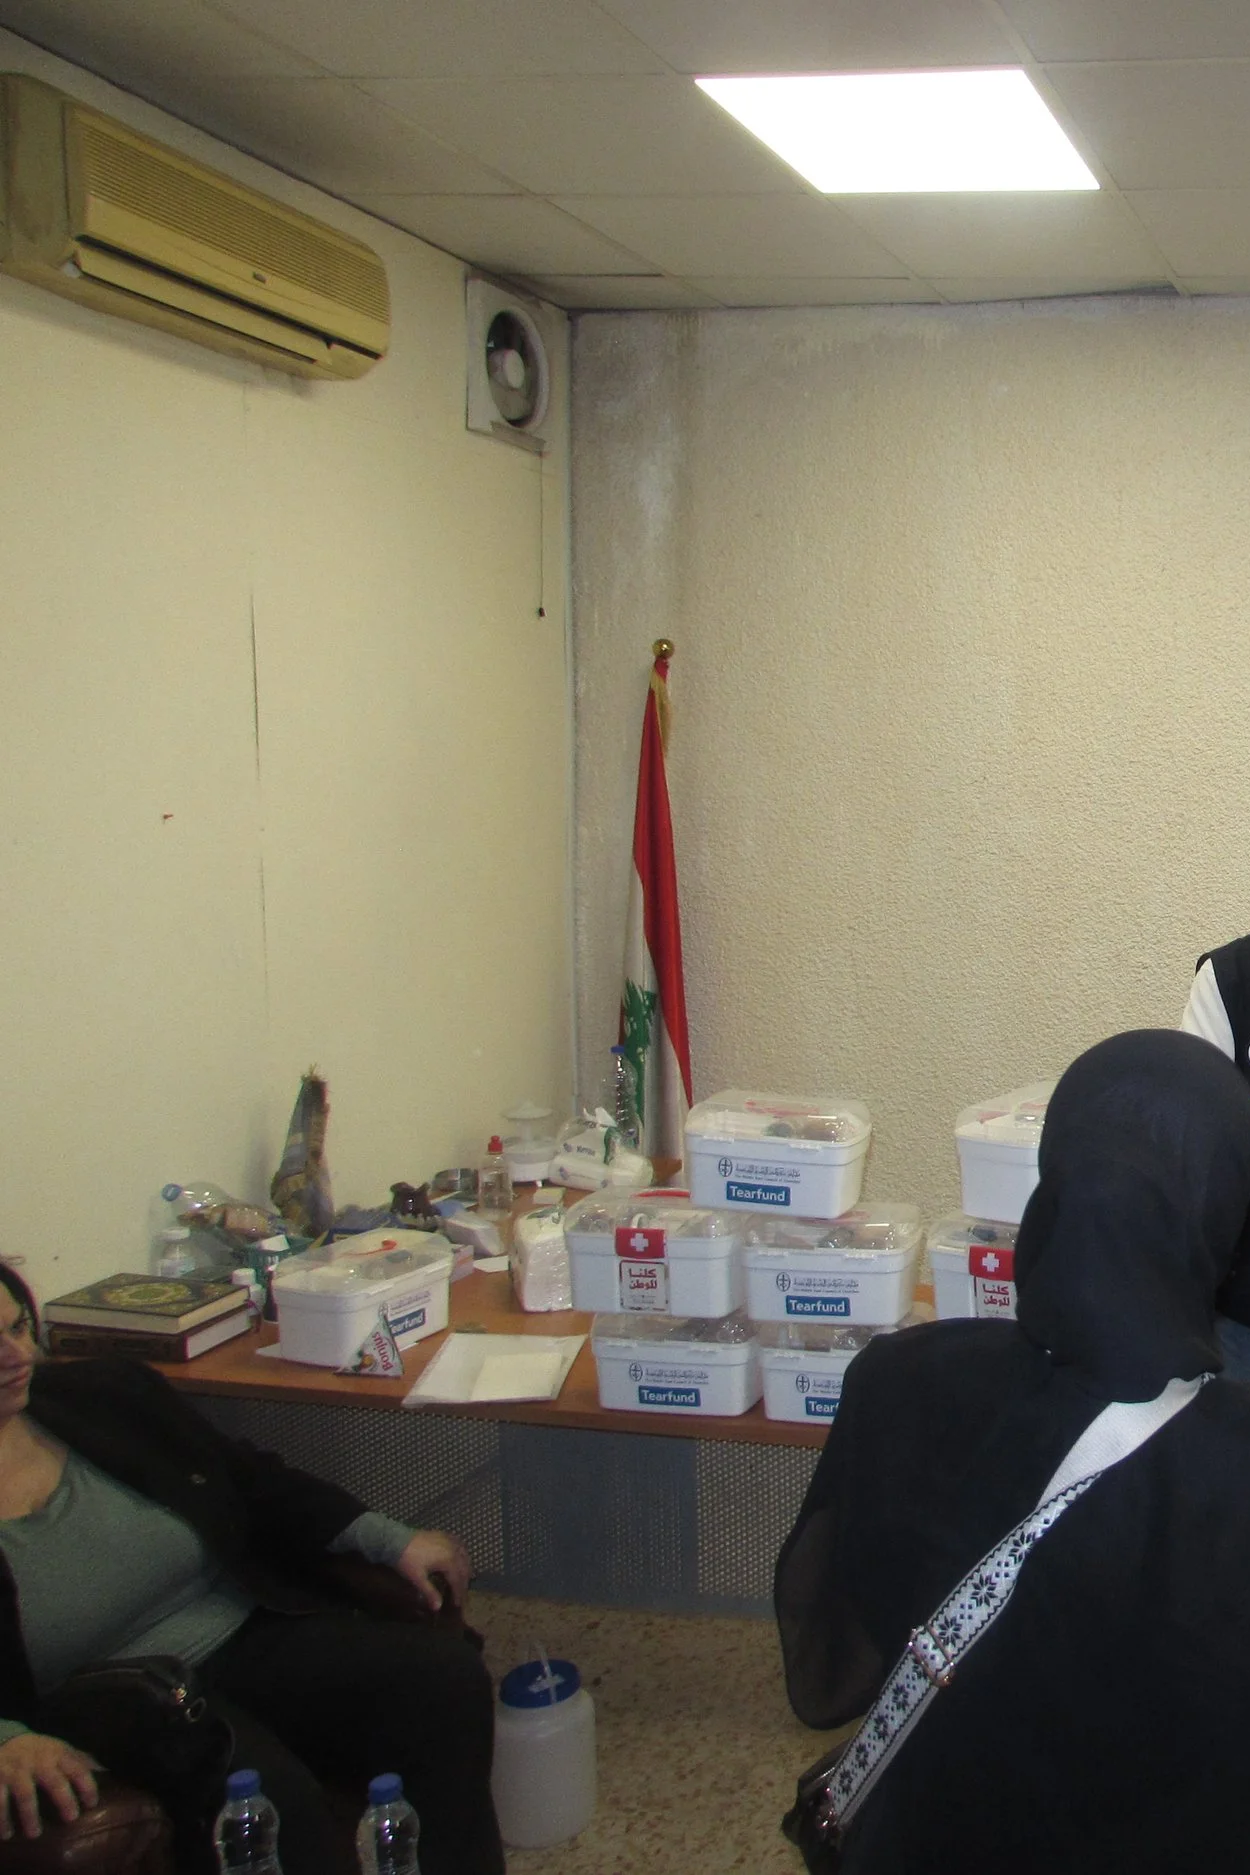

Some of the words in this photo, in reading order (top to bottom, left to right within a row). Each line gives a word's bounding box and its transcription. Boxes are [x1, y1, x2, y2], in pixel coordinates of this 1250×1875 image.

[729, 1185, 786, 1202] Tearfund
[628, 1268, 657, 1278] كلنا
[629, 1279, 658, 1290] للوطن
[982, 1283, 1009, 1295] كلنا
[789, 1299, 846, 1313] Tearfund
[983, 1295, 1010, 1307] للوطن
[371, 1331, 394, 1372] Bonjus
[641, 1389, 696, 1403] Tearfund
